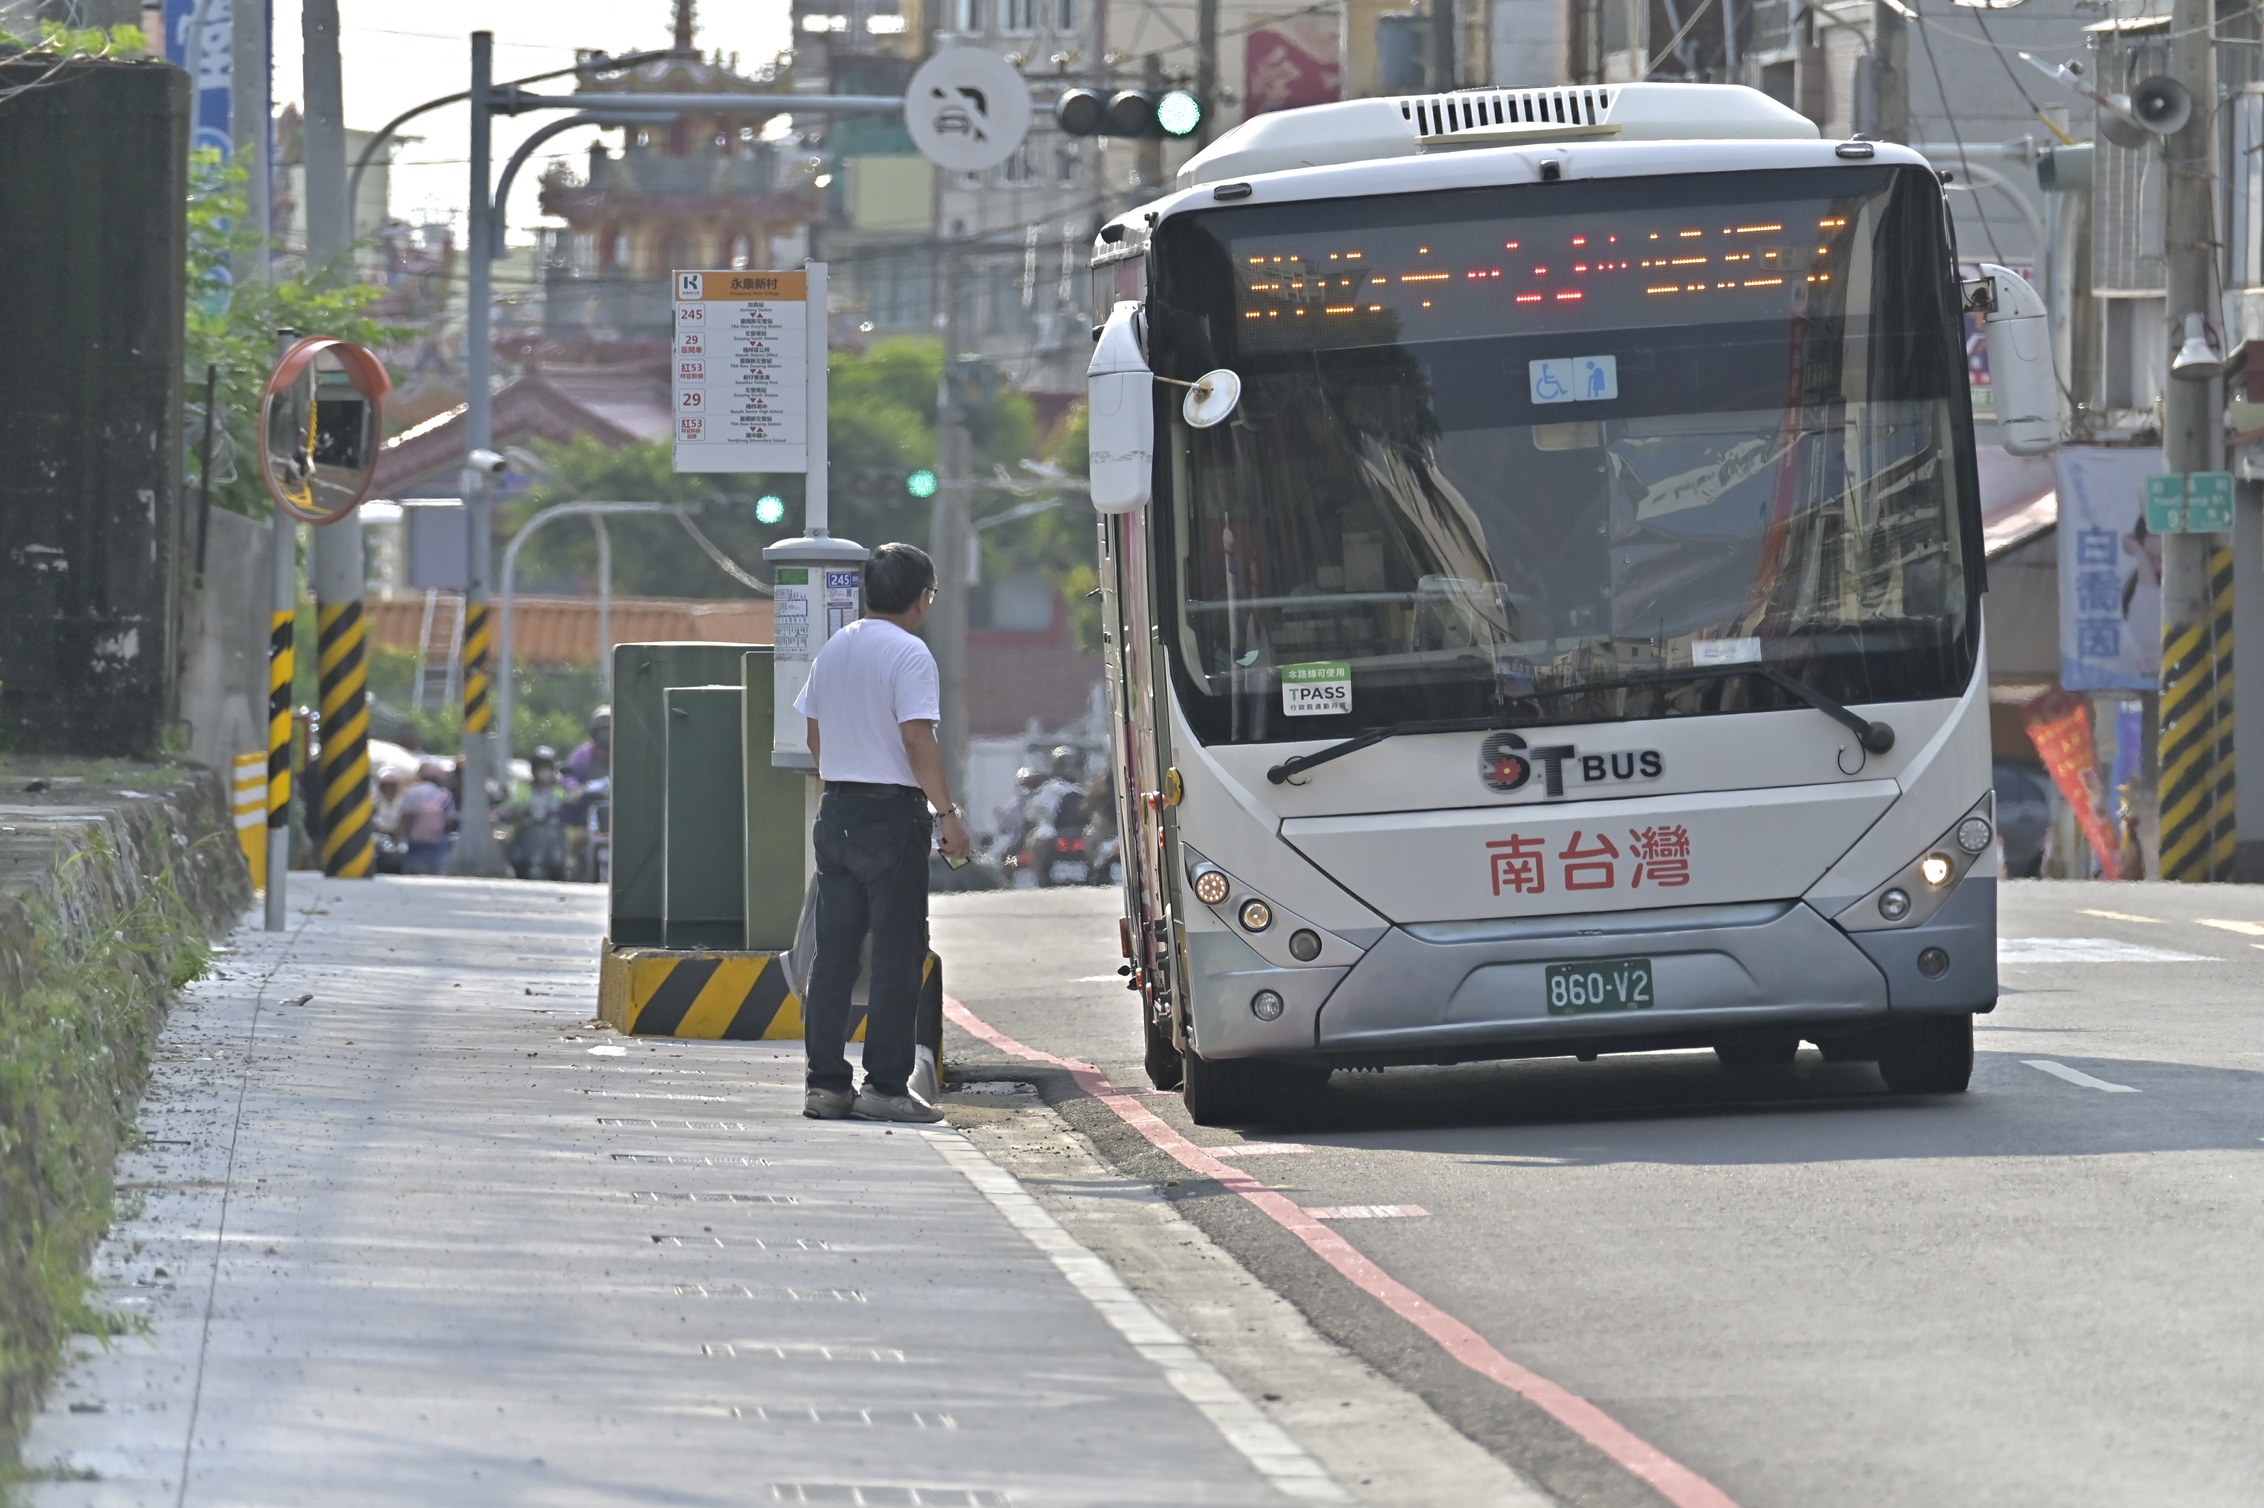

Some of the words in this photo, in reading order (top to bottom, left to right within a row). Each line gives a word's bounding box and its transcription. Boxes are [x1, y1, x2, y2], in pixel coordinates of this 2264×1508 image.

[730, 278, 778, 290] 永康新村
[681, 310, 703, 320] 245
[685, 335, 698, 345] 29
[681, 363, 702, 372] 紅53
[682, 393, 701, 406] 29
[681, 419, 702, 428] 紅53
[831, 574, 850, 585] 245
[1288, 668, 1345, 679] 本路線可使用
[1288, 686, 1346, 700] TPASS
[1582, 750, 1663, 782] BUS
[1485, 824, 1691, 897] 南台灣
[1551, 970, 1650, 1006] 860-V2
